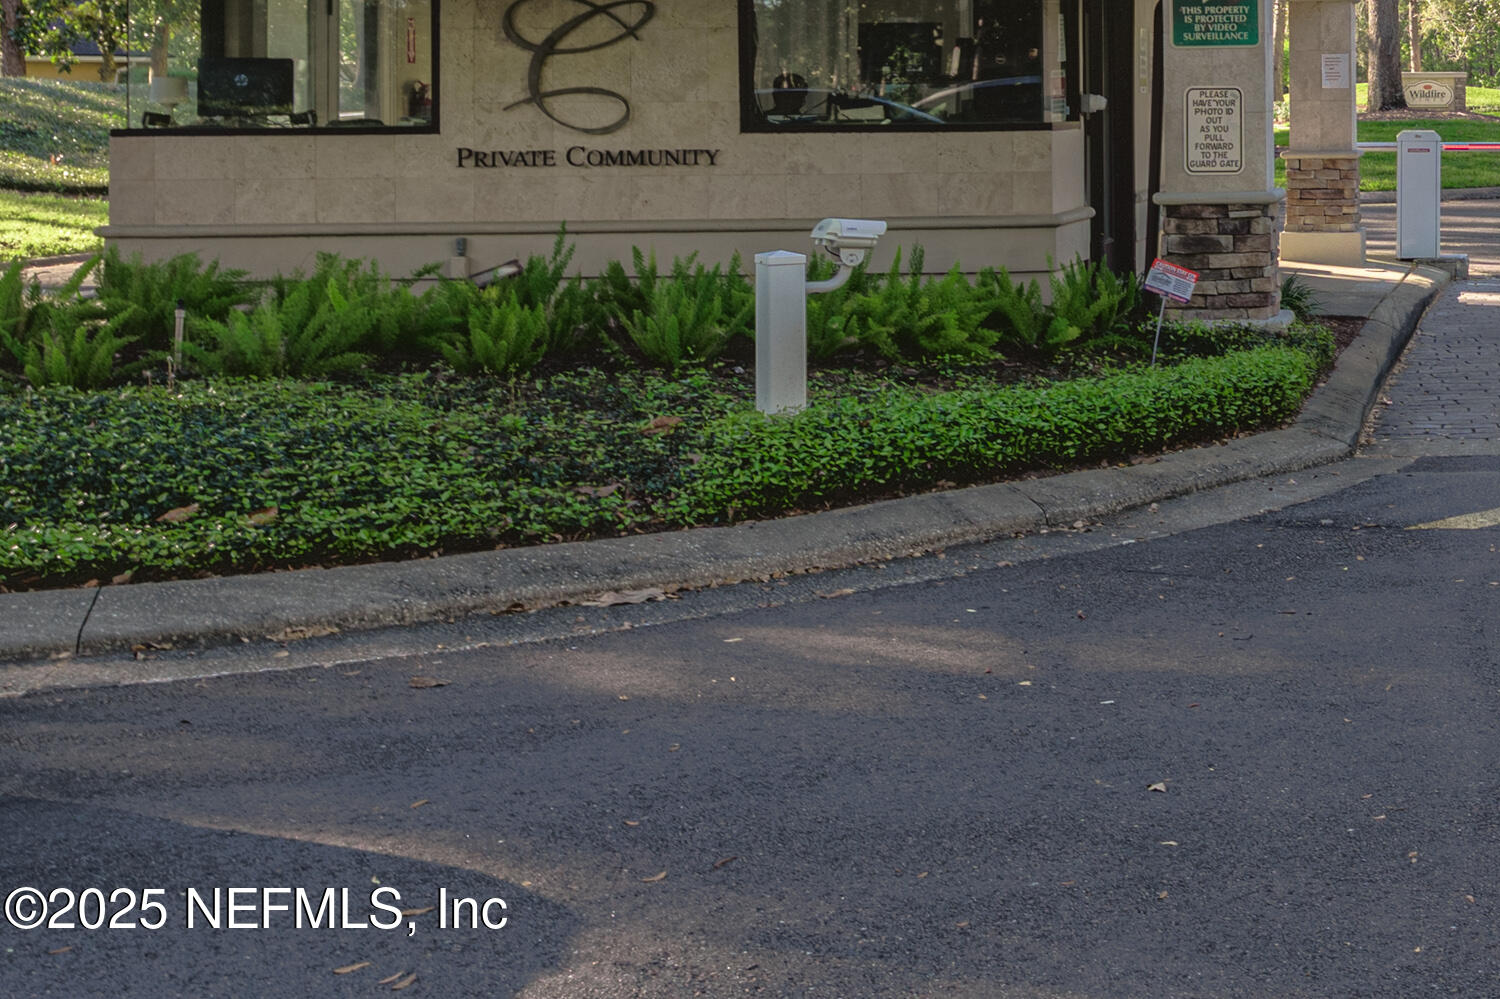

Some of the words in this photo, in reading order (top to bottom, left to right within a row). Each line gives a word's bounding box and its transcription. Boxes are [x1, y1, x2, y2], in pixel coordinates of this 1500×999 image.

[1181, 6, 1202, 14] THIS
[1204, 5, 1250, 14] PROPERTY
[1184, 15, 1193, 23] IS
[1195, 14, 1247, 23] PROTECTED
[1194, 23, 1206, 31] BY
[1207, 23, 1238, 31] VIDEO
[1183, 32, 1249, 40] SURVEILLANCE
[1409, 89, 1446, 98] Wildfire
[1192, 99, 1212, 107] HAVE
[1213, 99, 1236, 107] YOUR
[1200, 125, 1210, 133] AS
[1213, 125, 1229, 133] YOU
[456, 147, 556, 168] PRIVATE
[566, 146, 721, 168] COMMUNITY
[1212, 151, 1229, 159] THE
[1190, 160, 1217, 168] GUARD
